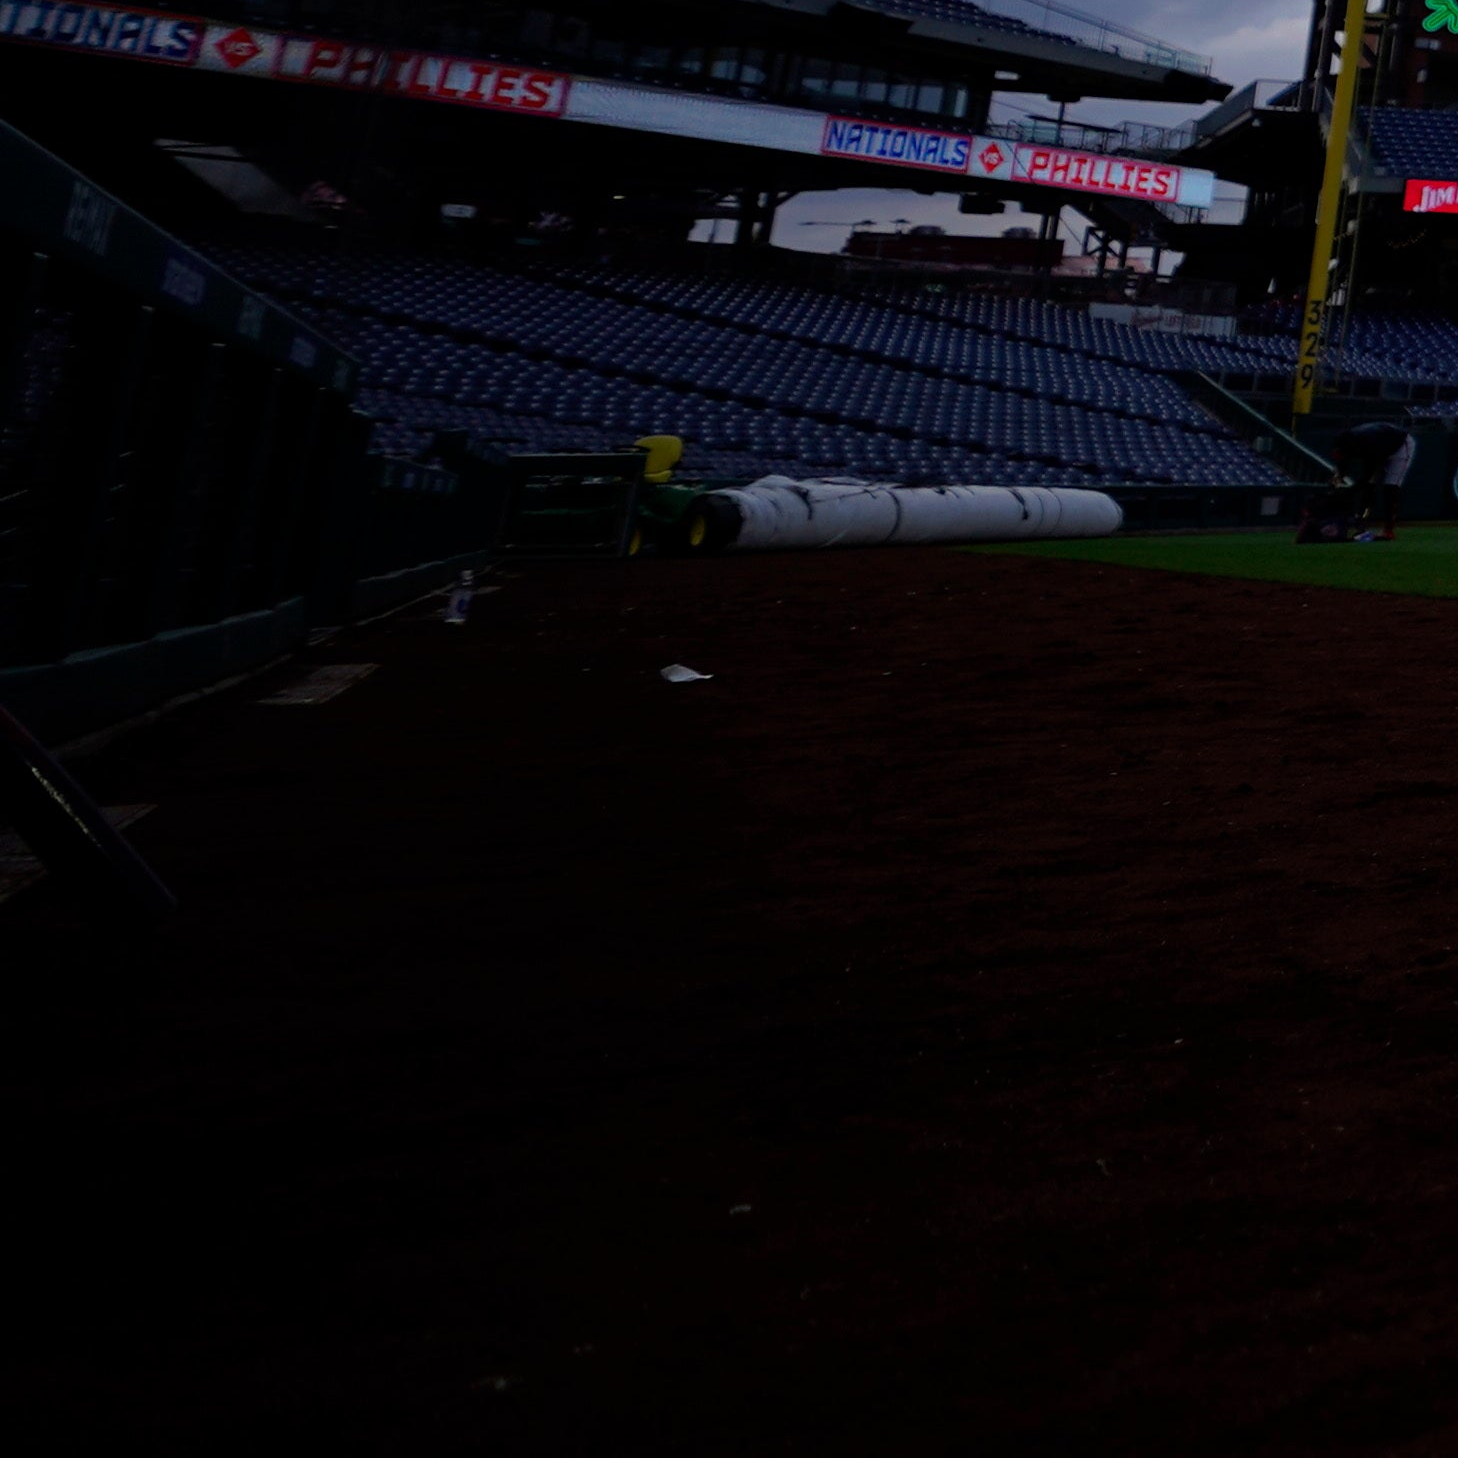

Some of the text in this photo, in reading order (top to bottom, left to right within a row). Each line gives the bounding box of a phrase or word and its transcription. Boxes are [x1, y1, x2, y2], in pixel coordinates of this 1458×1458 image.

[305, 41, 553, 108] PHILLIES
[827, 121, 969, 167] NATIONALS
[1028, 151, 1174, 196] PHILLIES
[1413, 184, 1456, 213] JIM
